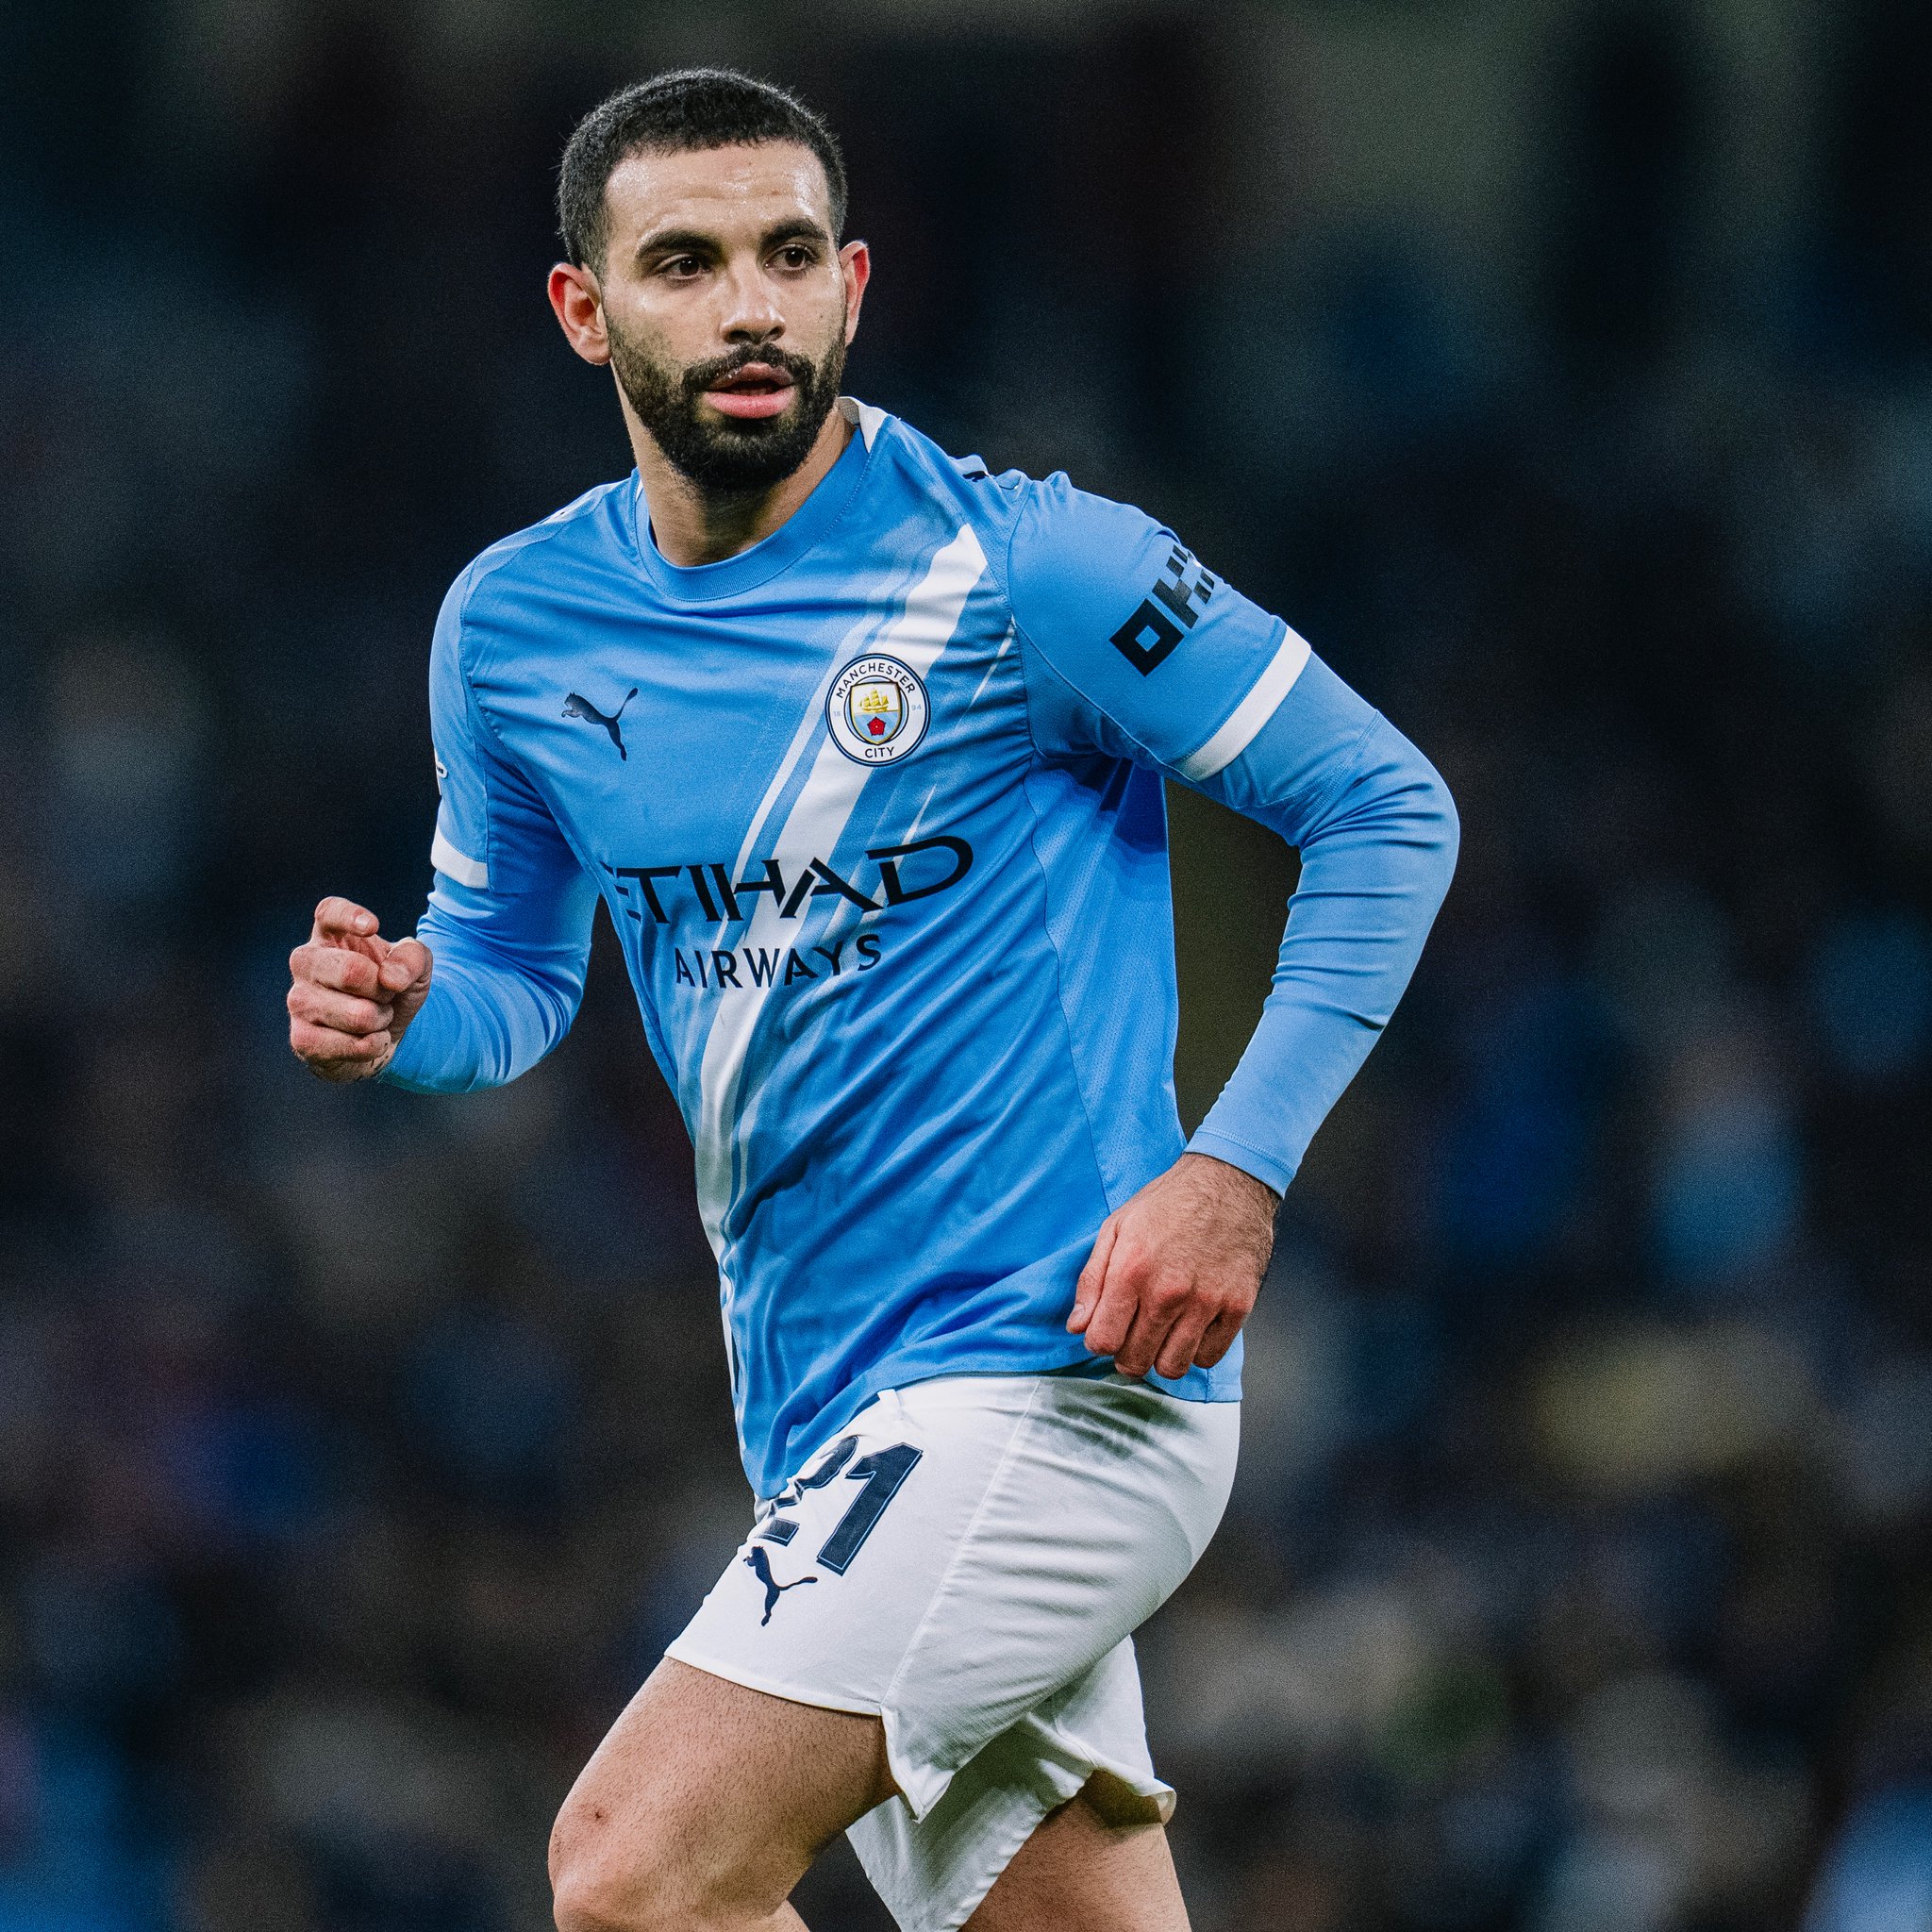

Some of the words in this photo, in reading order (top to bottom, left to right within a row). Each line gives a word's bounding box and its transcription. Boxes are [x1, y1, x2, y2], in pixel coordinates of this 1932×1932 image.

[836, 662, 916, 699] MANCHESTER
[864, 746, 894, 758] CITY
[675, 934, 884, 989] AIRWAYS
